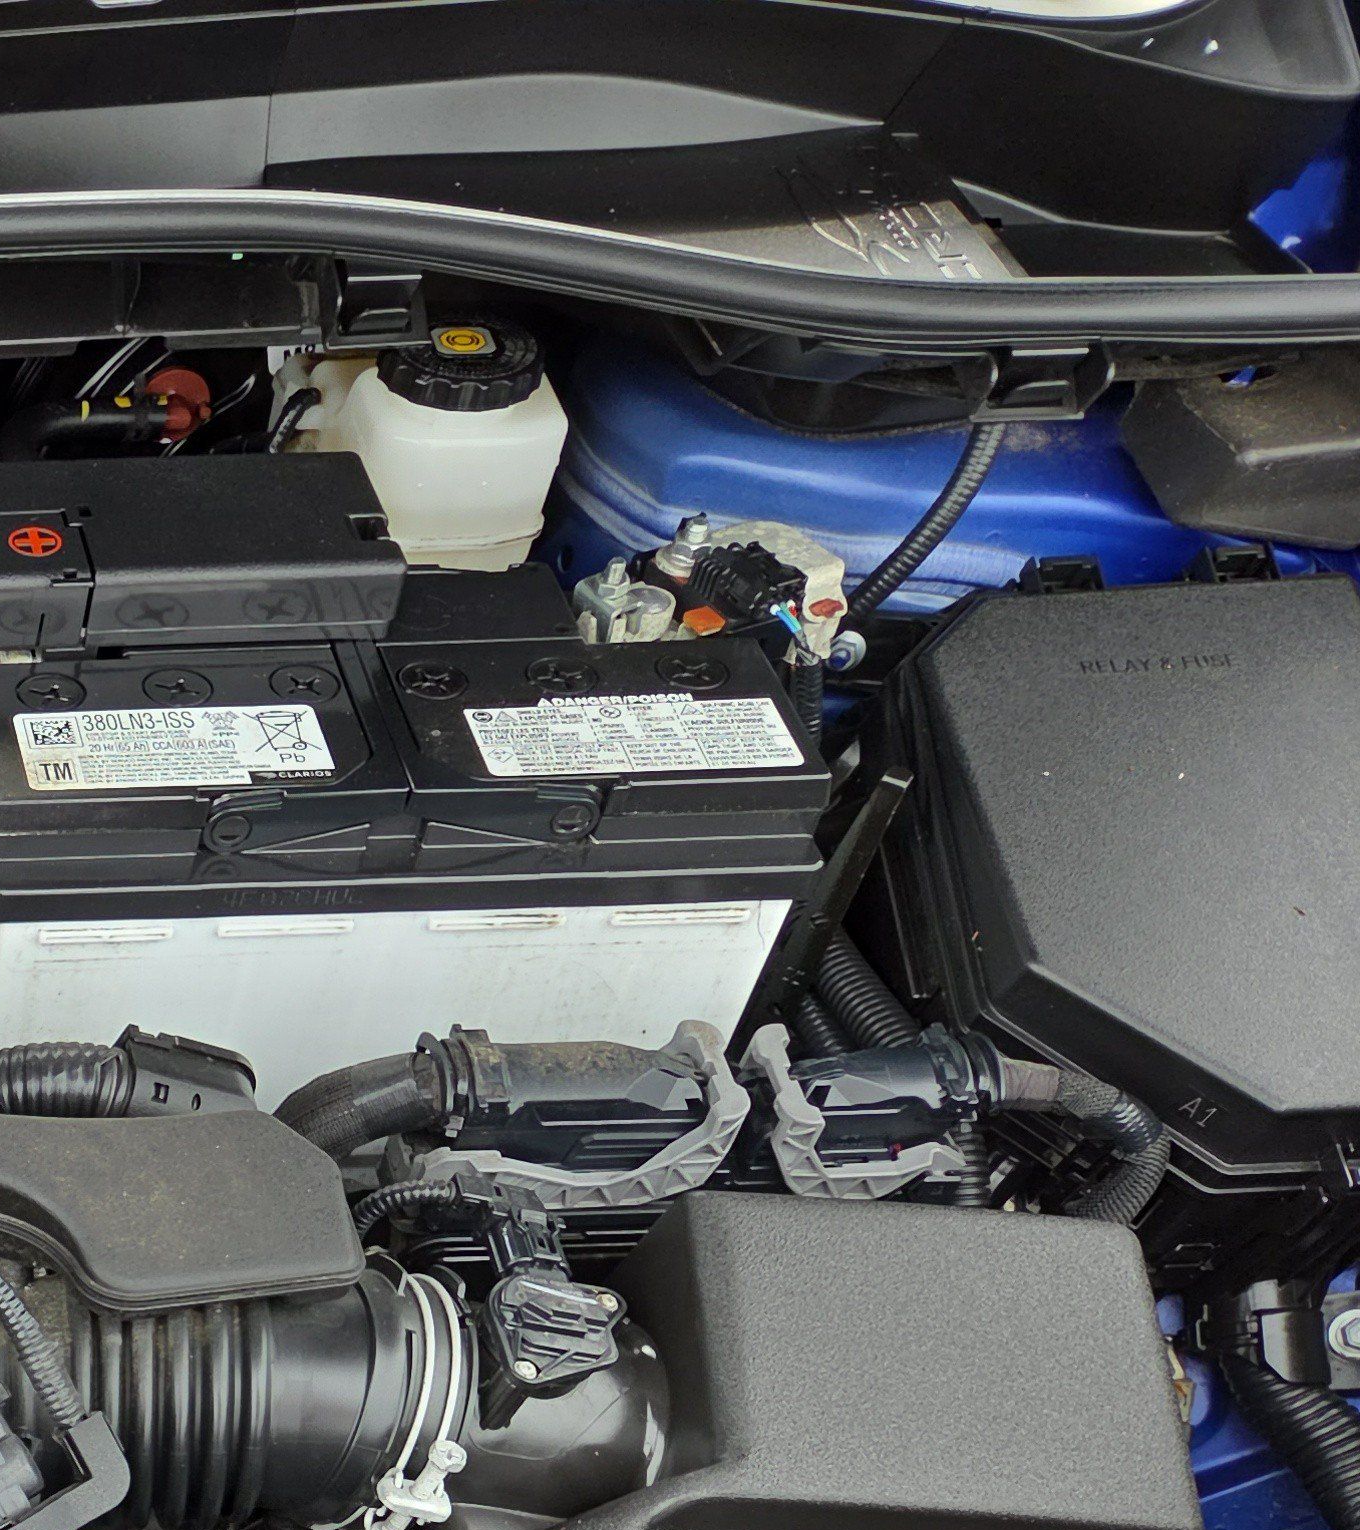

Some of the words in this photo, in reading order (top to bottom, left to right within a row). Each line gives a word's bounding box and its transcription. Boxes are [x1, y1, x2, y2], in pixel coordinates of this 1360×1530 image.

[1079, 658, 1151, 674] RELAY
[1159, 656, 1174, 670] &
[1181, 653, 1235, 669] FUSE
[81, 710, 196, 731] 380LN3-ISS
[279, 753, 306, 764] Pb
[39, 762, 74, 781] TM
[278, 770, 333, 779] CLARIOS
